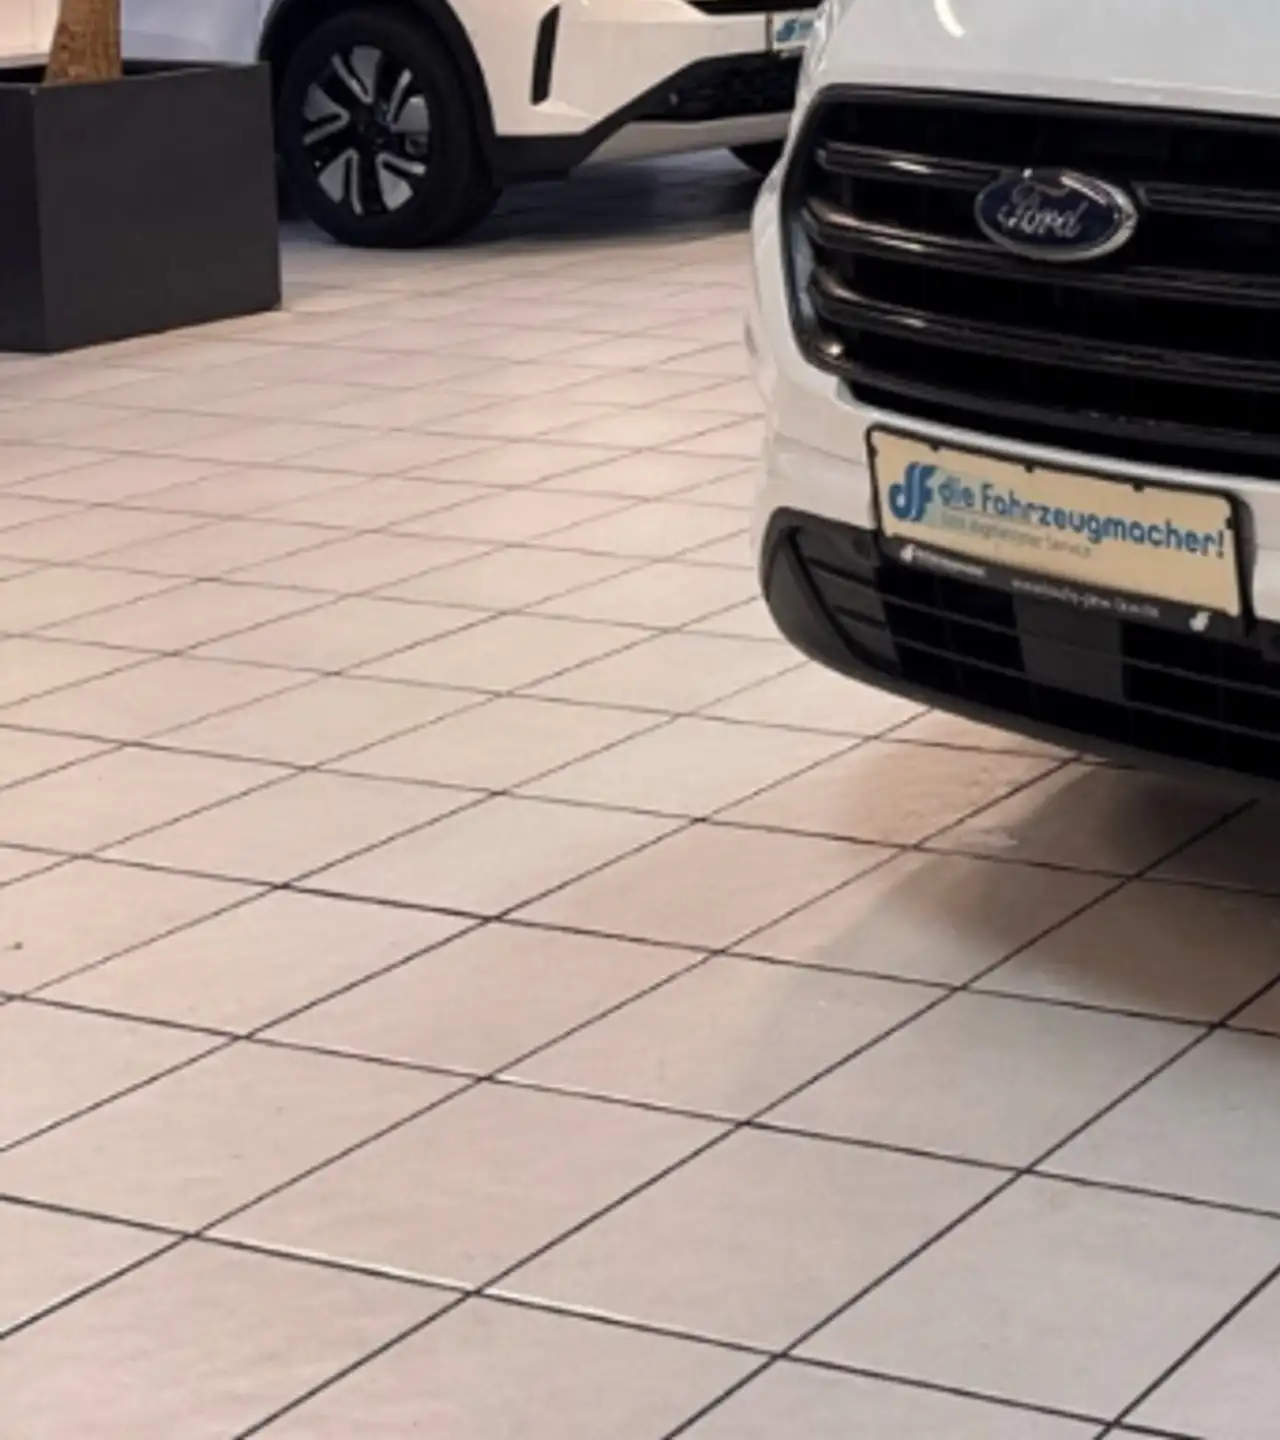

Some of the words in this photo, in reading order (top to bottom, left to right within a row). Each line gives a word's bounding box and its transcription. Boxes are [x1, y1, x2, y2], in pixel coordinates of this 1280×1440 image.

[997, 180, 1090, 238] Ford
[938, 473, 976, 509] die
[981, 482, 1225, 559] Fahrzeugmacher!
